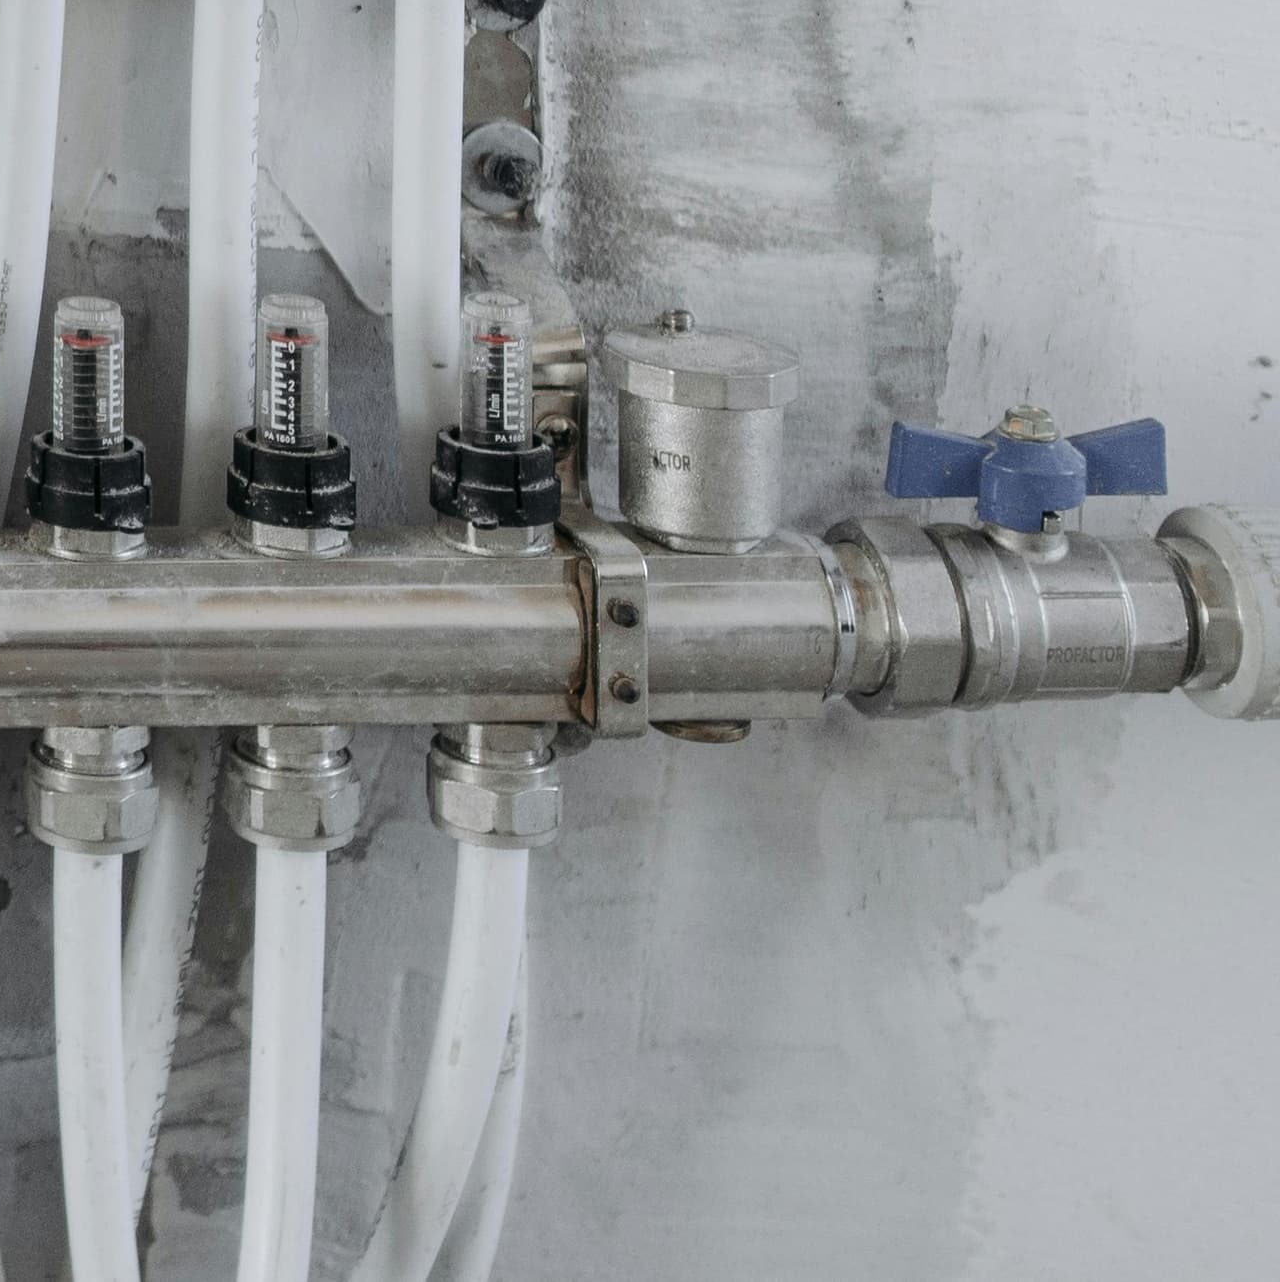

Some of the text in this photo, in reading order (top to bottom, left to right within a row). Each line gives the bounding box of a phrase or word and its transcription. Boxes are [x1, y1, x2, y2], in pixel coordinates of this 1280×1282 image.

[288, 341, 295, 354] 0
[289, 359, 295, 371] 1
[288, 380, 295, 392] 2
[288, 397, 295, 409] 3
[288, 410, 295, 422] 4
[288, 424, 295, 435] 5
[1047, 646, 1125, 665] PROFACTOR
